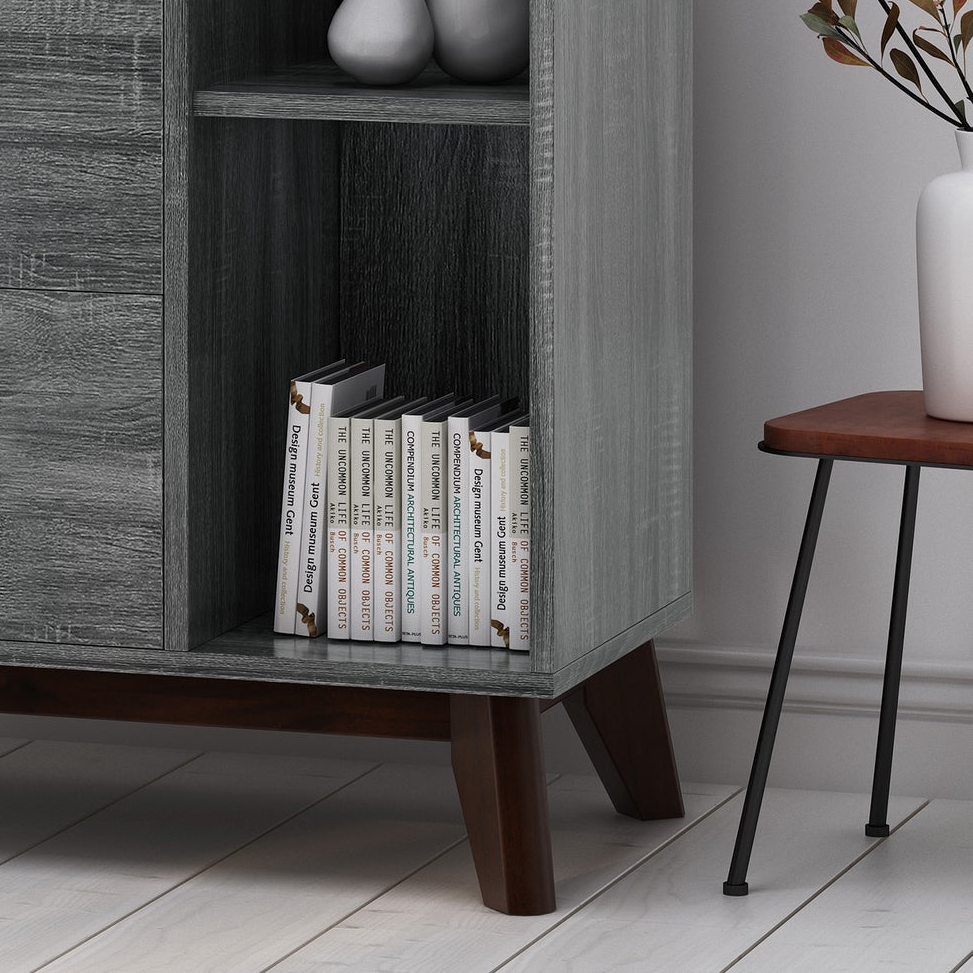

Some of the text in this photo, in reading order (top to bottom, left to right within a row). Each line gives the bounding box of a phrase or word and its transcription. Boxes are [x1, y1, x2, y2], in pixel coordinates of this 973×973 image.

[285, 424, 301, 536] Design museum Gent
[303, 482, 320, 593] Design museum Gent
[314, 452, 324, 477] History
[337, 427, 347, 630] THE UNCOMMON LIFE OF COMMON OBJECTS
[361, 428, 371, 631] THE UNCOMMON LIFE OF COMMON OBJECTS
[384, 429, 394, 633] THE UNCOMMON LIFE OF COMMON OBJECTS
[406, 430, 415, 614] COMPENDIUM ARCHITECTURAL ANTIQUES
[431, 431, 441, 635] THE UNCOMMON LIFE OF COMMON OBJECTS
[452, 433, 461, 617] COMPENDIUM ARCHITECTURAL ANTIQUES
[471, 468, 484, 563] Design museum Gent
[520, 436, 529, 641] THE UNCOMMON LIFE OF COMMON OBJECTS
[496, 516, 509, 611] Design museum Gent
